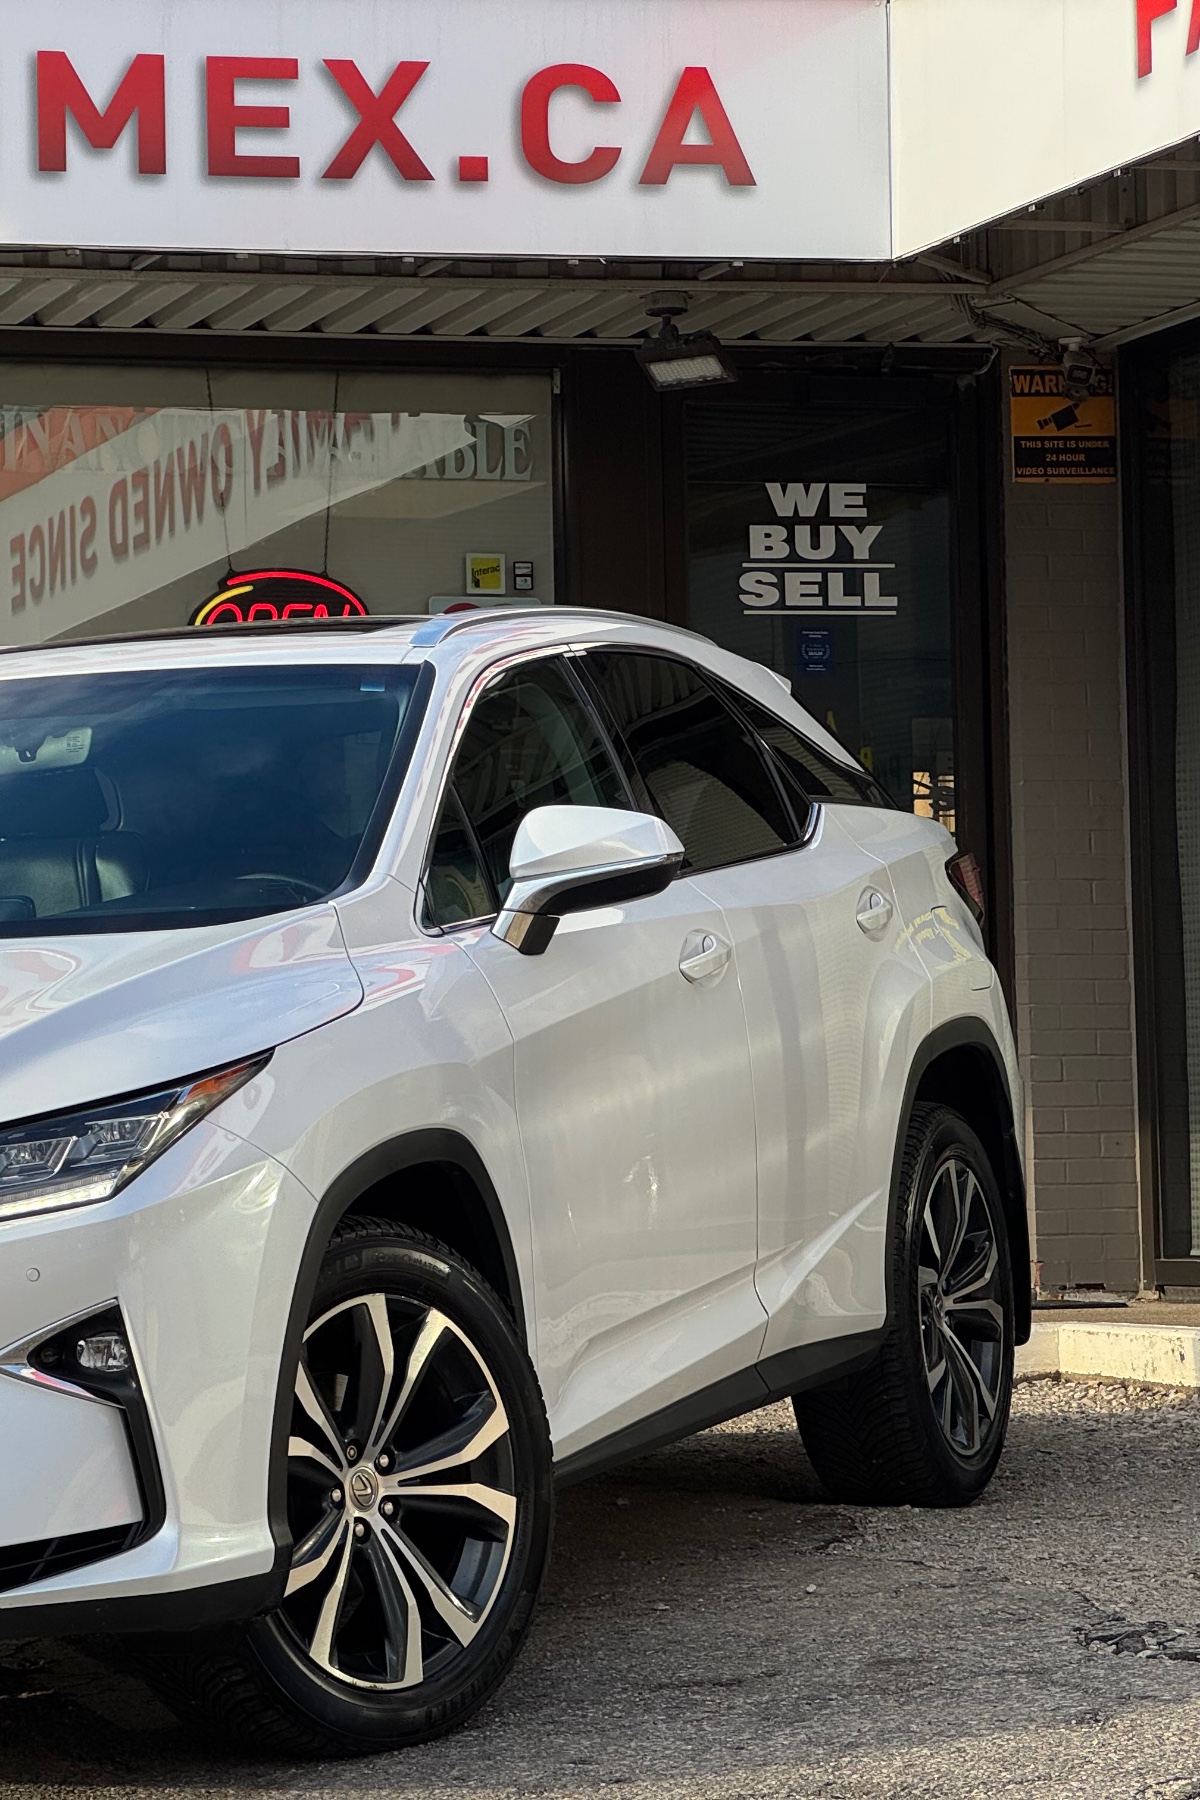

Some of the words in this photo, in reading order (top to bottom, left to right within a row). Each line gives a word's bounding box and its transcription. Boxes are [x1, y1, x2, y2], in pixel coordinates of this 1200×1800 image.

[1020, 440, 1042, 448] THIS
[1044, 440, 1065, 449] SITE
[1067, 440, 1076, 448] IS
[1078, 440, 1110, 449] UNDER
[1045, 453, 1057, 462] 24
[1059, 453, 1086, 462] HOUR
[1016, 467, 1045, 475] VIDEO
[1046, 467, 1115, 475] SURVEILLANCE
[765, 482, 868, 518] WE
[748, 525, 884, 560] BUY
[471, 564, 501, 580] Interac
[738, 571, 899, 608] SELL
